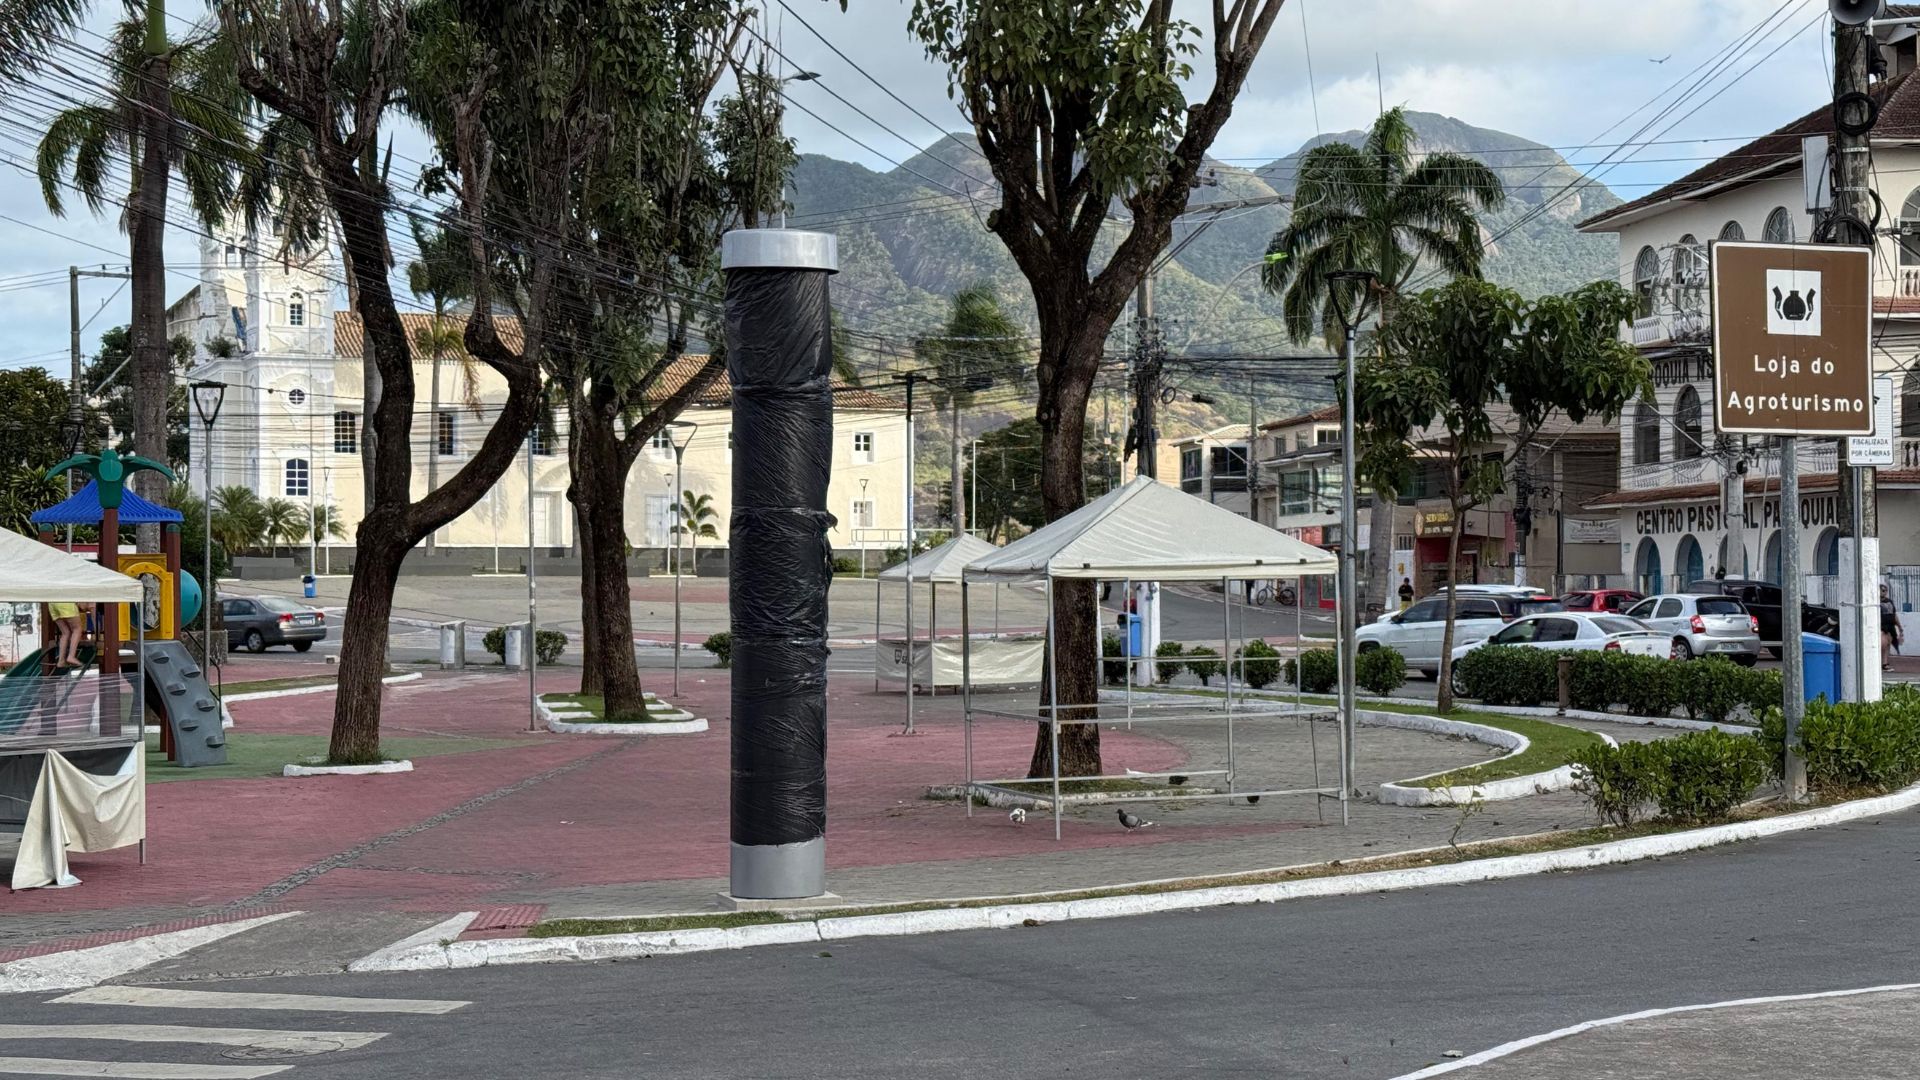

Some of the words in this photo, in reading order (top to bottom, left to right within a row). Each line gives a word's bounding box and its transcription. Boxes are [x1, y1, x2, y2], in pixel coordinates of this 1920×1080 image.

[1754, 354, 1800, 379] Loja
[1811, 357, 1834, 375] do
[1727, 391, 1864, 415] Agroturismo
[1851, 449, 1863, 457] POR
[1852, 438, 1889, 446] FISCALIZADA
[1636, 505, 1684, 535] CENTRO
[1687, 501, 1758, 532] PASTAL
